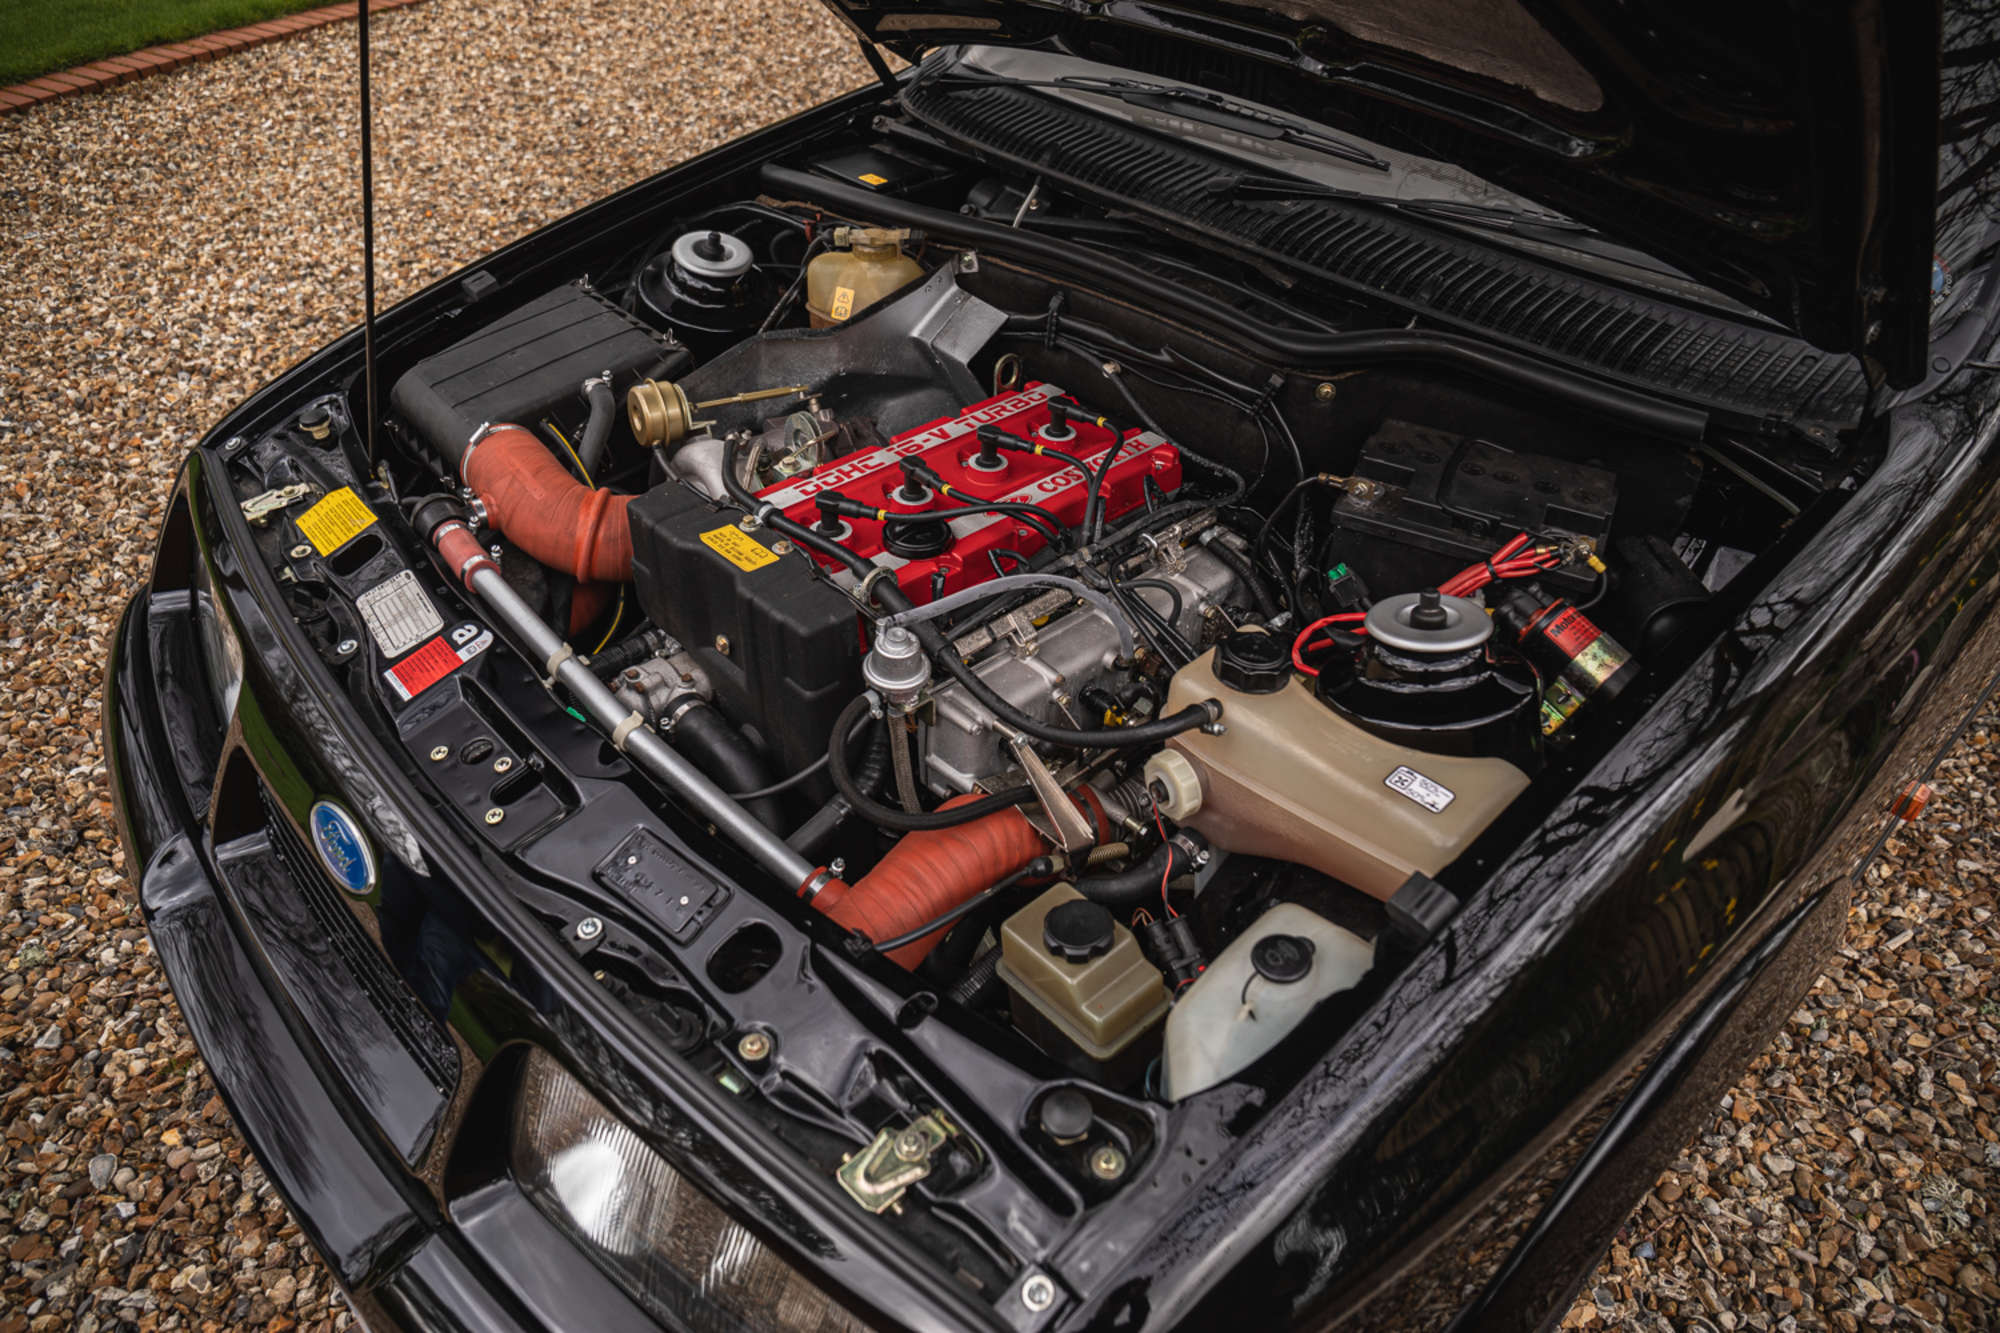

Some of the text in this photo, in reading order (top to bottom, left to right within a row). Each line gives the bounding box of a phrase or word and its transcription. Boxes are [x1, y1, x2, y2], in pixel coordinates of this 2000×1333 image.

[793, 455, 886, 497] DOHC
[953, 391, 1048, 429] TURBO
[320, 820, 357, 872] Ford
